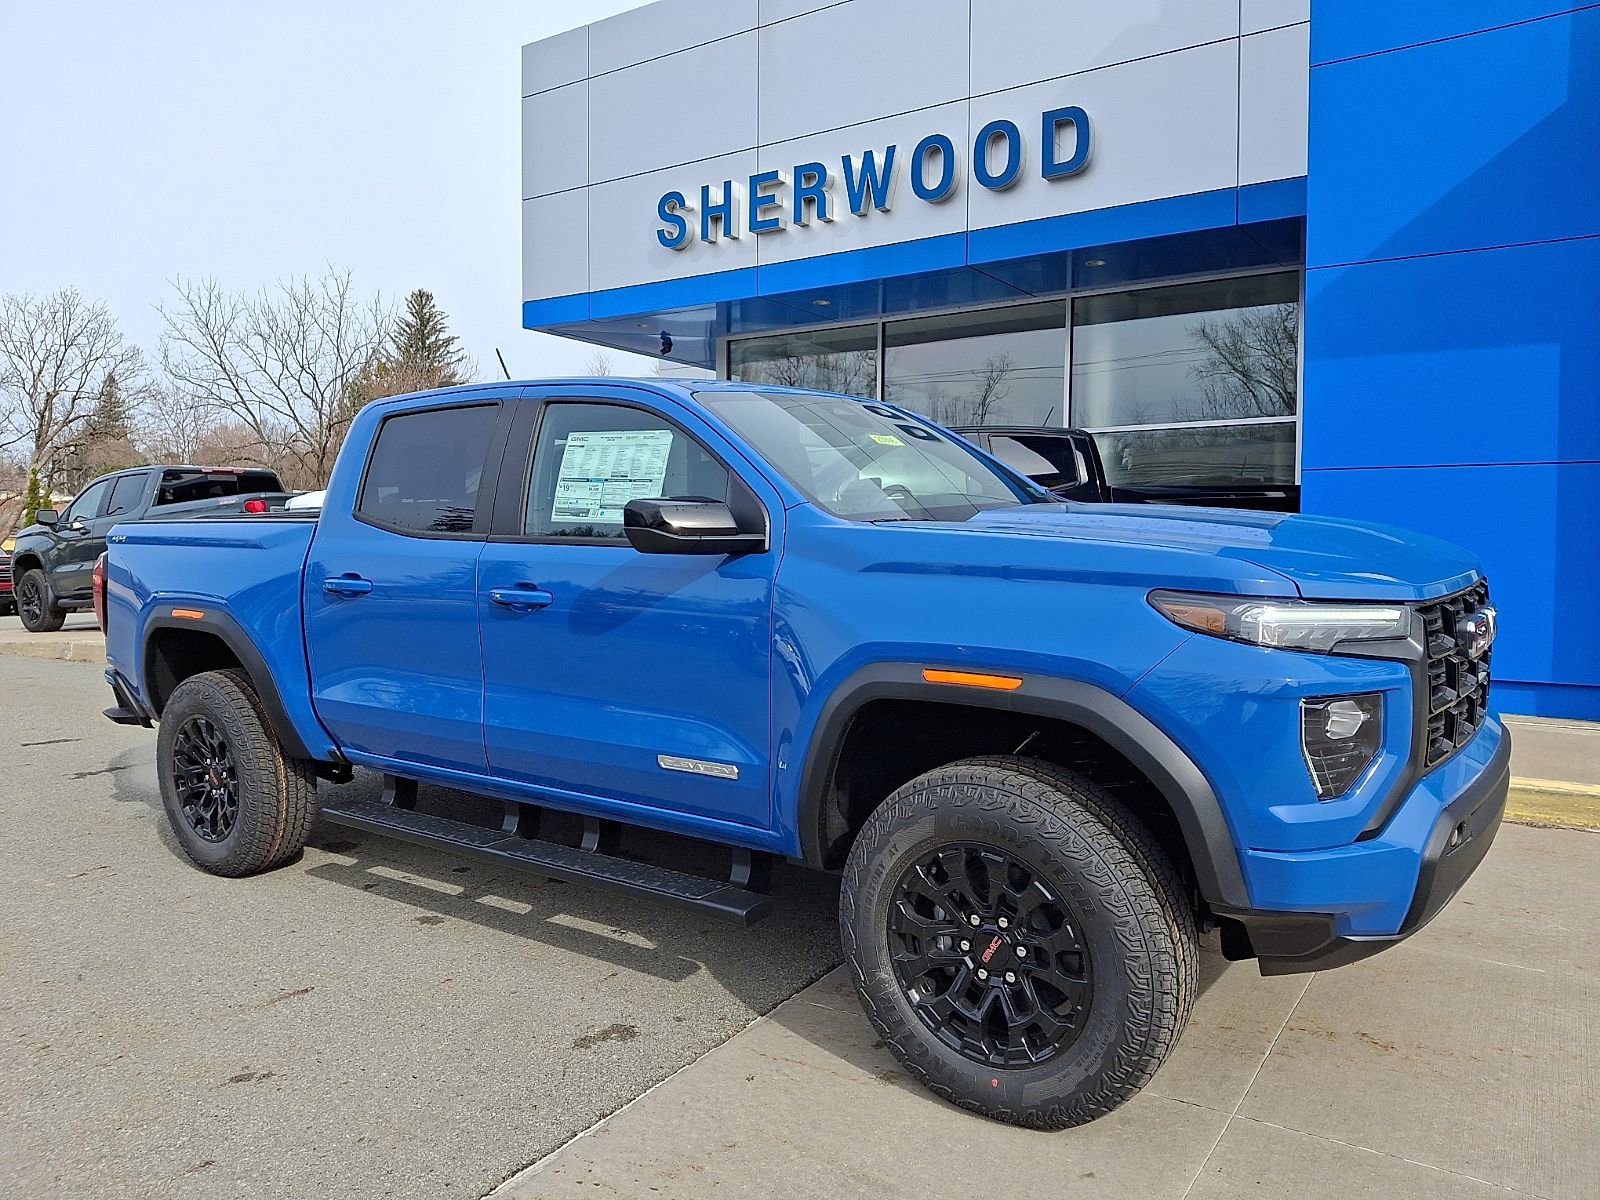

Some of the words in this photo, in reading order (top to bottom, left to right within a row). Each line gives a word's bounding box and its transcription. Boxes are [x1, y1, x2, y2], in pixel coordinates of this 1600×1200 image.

[656, 105, 1093, 250] SHERWOOD
[664, 758, 732, 774] ELEVATION
[981, 935, 1002, 963] GMC
